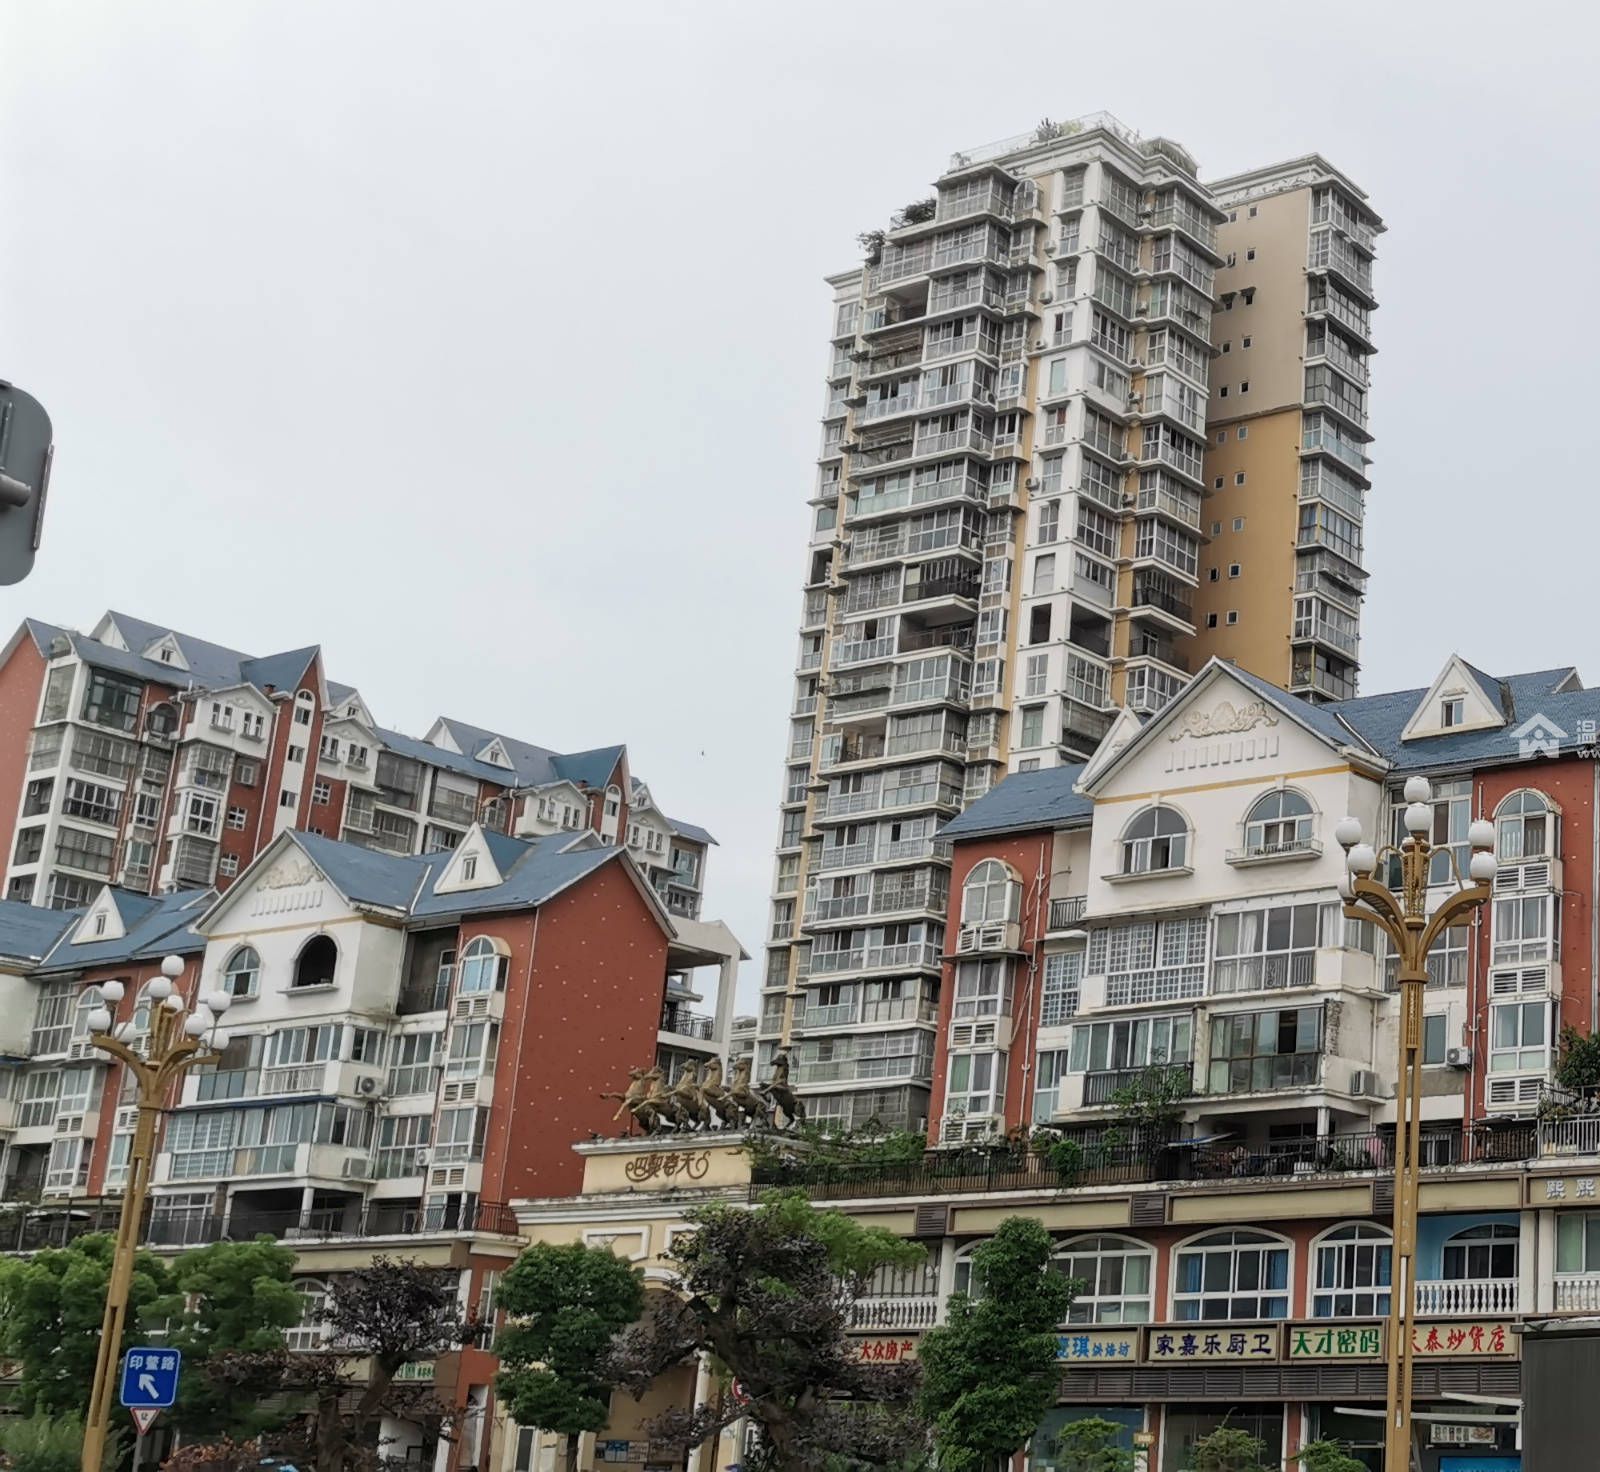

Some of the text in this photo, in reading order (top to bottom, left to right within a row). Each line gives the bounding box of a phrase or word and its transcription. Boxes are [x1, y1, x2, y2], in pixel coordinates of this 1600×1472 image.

[859, 1339, 913, 1361] 大众房产
[1155, 1333, 1272, 1356] 家嘉乐厨卫
[1291, 1328, 1380, 1355] 天才密码
